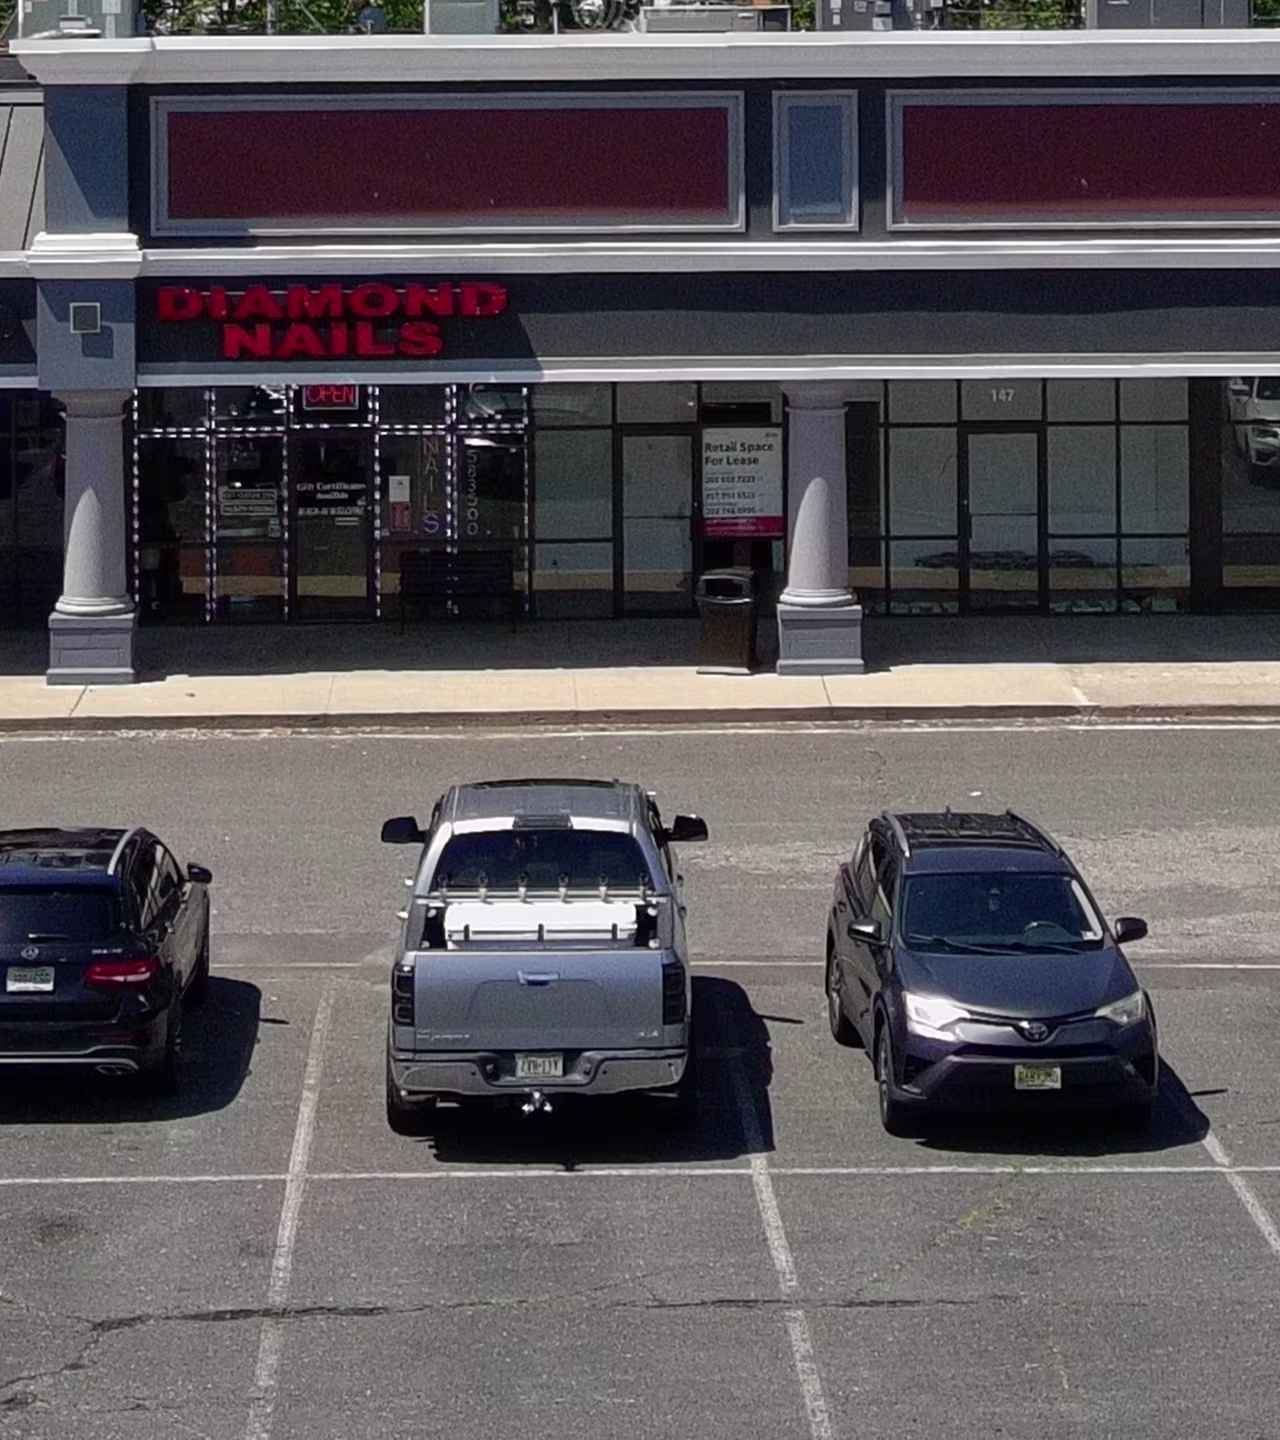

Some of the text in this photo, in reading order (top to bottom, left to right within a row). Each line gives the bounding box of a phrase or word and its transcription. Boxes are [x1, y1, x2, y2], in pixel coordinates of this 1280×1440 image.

[156, 282, 508, 321] DIAMOND
[223, 321, 444, 357] NAILS
[306, 385, 355, 402] OPEN
[990, 388, 1015, 402] 147
[704, 441, 774, 453] Retail Space
[704, 456, 760, 466] For Lease
